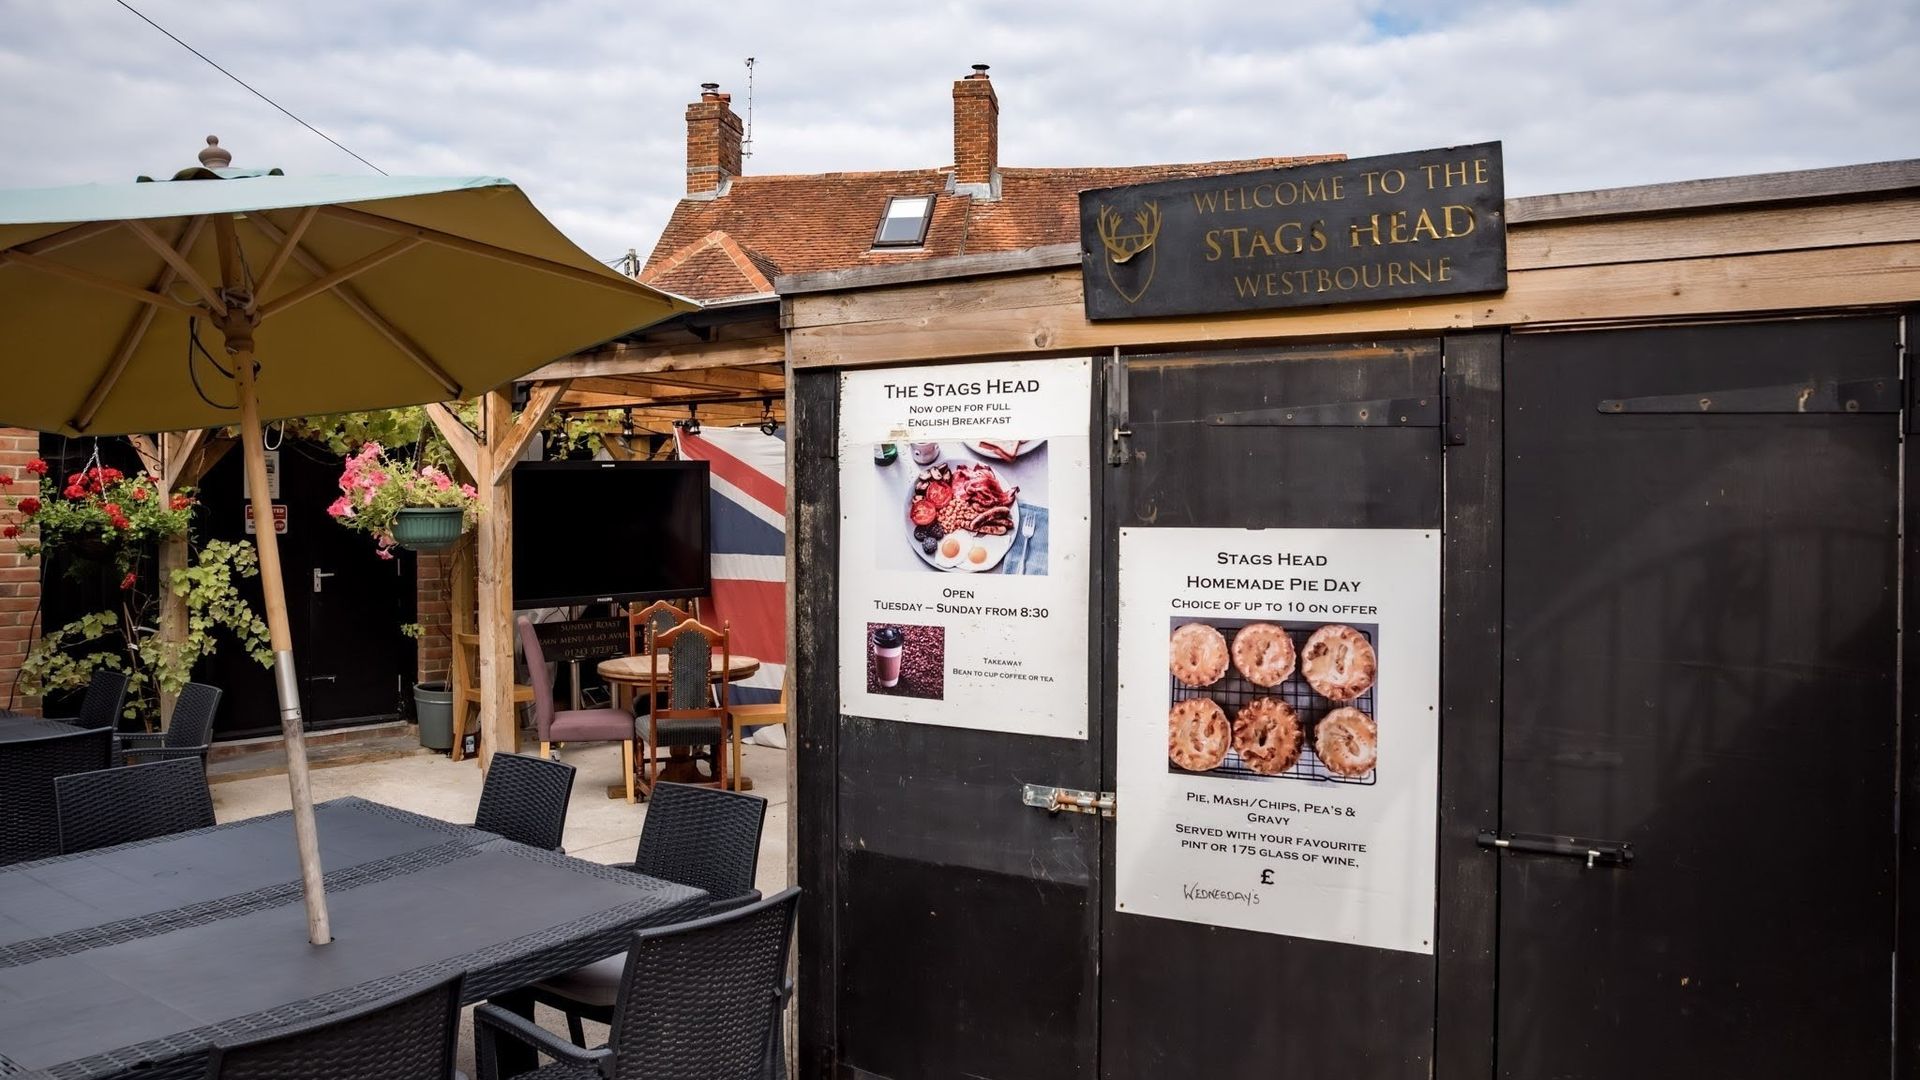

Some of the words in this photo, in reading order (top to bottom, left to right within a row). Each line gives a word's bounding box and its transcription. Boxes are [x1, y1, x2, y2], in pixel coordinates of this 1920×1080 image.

[1193, 177, 1344, 215] WELCOME
[1361, 170, 1406, 196] TO
[1421, 159, 1489, 189] THE
[1205, 220, 1327, 262] STAGS
[1350, 204, 1476, 248] HEAD
[1234, 257, 1453, 298] WESTBOURNE
[884, 385, 918, 398] THE
[924, 383, 981, 397] STAGS
[987, 379, 1039, 394] HEAD
[935, 405, 961, 413] OPEN
[986, 403, 1010, 411] FULL
[908, 419, 949, 427] ENGLISH
[952, 417, 1011, 425] BREAKFAST
[1218, 552, 1272, 565] STAGS
[1279, 553, 1327, 566] HEAD
[1188, 576, 1284, 590] HOMEMADE
[1291, 578, 1318, 591] PIE
[1325, 579, 1360, 592] DAY
[943, 588, 974, 598] OPEN
[874, 600, 922, 611] TUESDAY
[937, 603, 982, 614] SUNDAY
[986, 607, 1017, 616] FROM
[1021, 608, 1048, 618] 8:30
[1172, 599, 1220, 609] CHOICE
[1224, 602, 1241, 610] OF
[1266, 603, 1282, 611] TO
[1289, 602, 1305, 612] 10
[1309, 604, 1327, 613] ON
[1332, 605, 1377, 614] OFFER
[561, 623, 593, 632] SUNDAY
[596, 620, 621, 628] ROAST
[559, 635, 584, 644] MENU
[609, 630, 643, 640] AVAILBL
[983, 657, 1022, 666] TAKEAWAY
[1187, 792, 1209, 803] PIE,
[1214, 795, 1300, 812] MASH/CHIPS,
[1305, 804, 1342, 815] PEA'S
[1345, 807, 1355, 817] &
[1248, 813, 1289, 825] GRAVY
[1176, 824, 1223, 837] SERVED
[1226, 831, 1256, 841] WITH
[1260, 834, 1292, 844] YOUR
[1297, 838, 1366, 852] FAVOURITE
[1182, 840, 1208, 849] PINT
[1211, 843, 1227, 852] OR
[1233, 845, 1256, 855] 175
[1259, 849, 1299, 860] GLASS
[1302, 854, 1318, 862] OF
[1261, 869, 1274, 885] £
